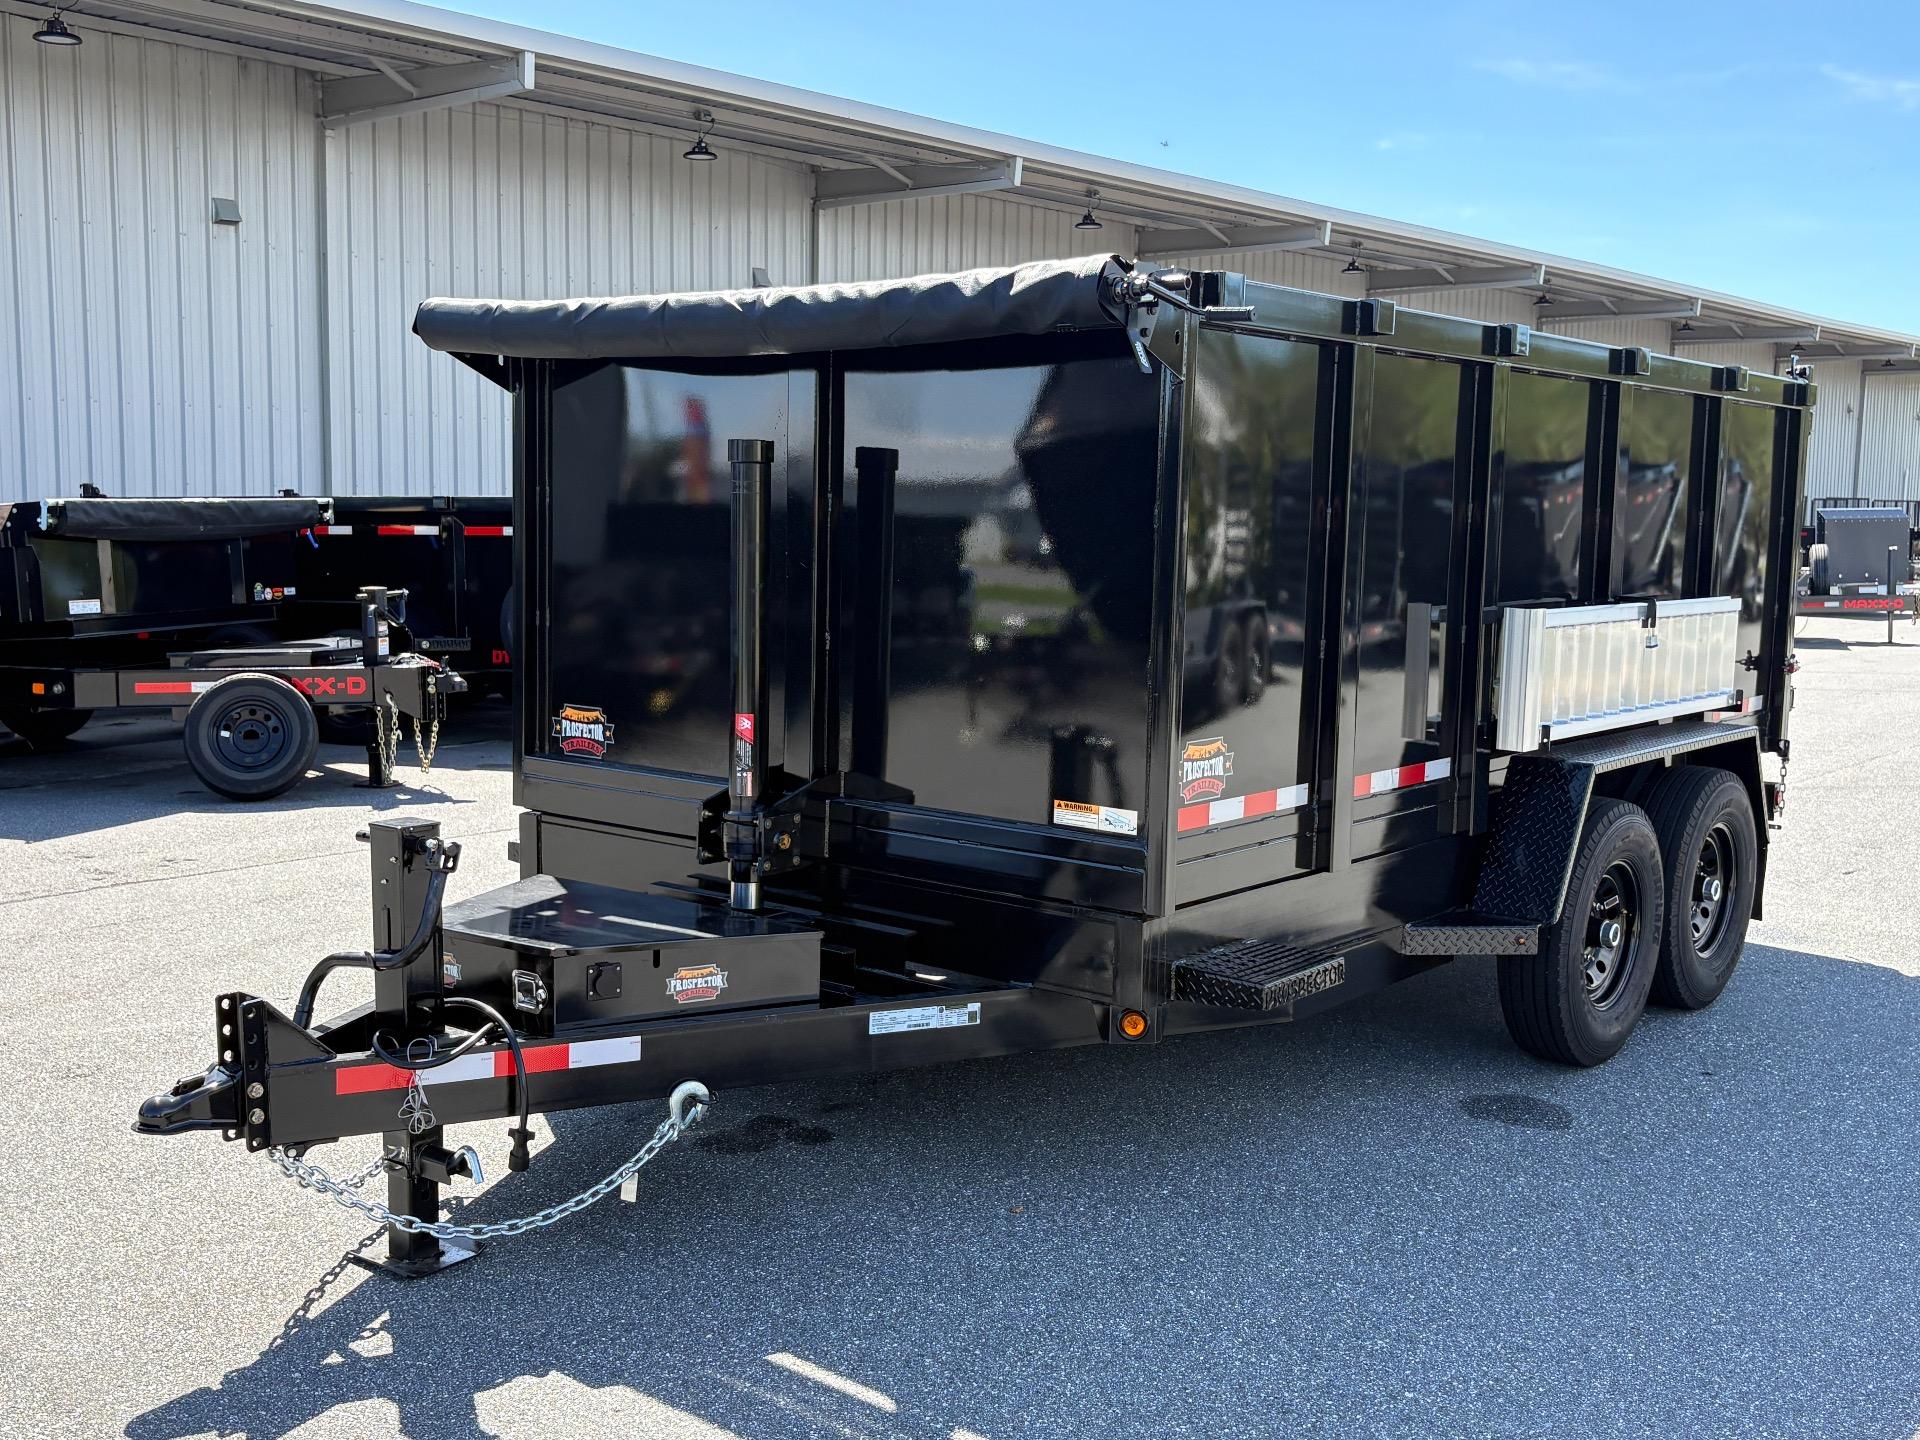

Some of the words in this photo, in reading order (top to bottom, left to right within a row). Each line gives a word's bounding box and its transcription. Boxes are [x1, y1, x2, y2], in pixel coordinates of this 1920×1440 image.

[562, 719, 605, 742] PROSPECTOR
[566, 739, 600, 754] TRAILERS
[1182, 755, 1224, 783] PROSPECTOR
[1063, 801, 1093, 813] WARNING
[670, 974, 724, 993] PROSPECTOR
